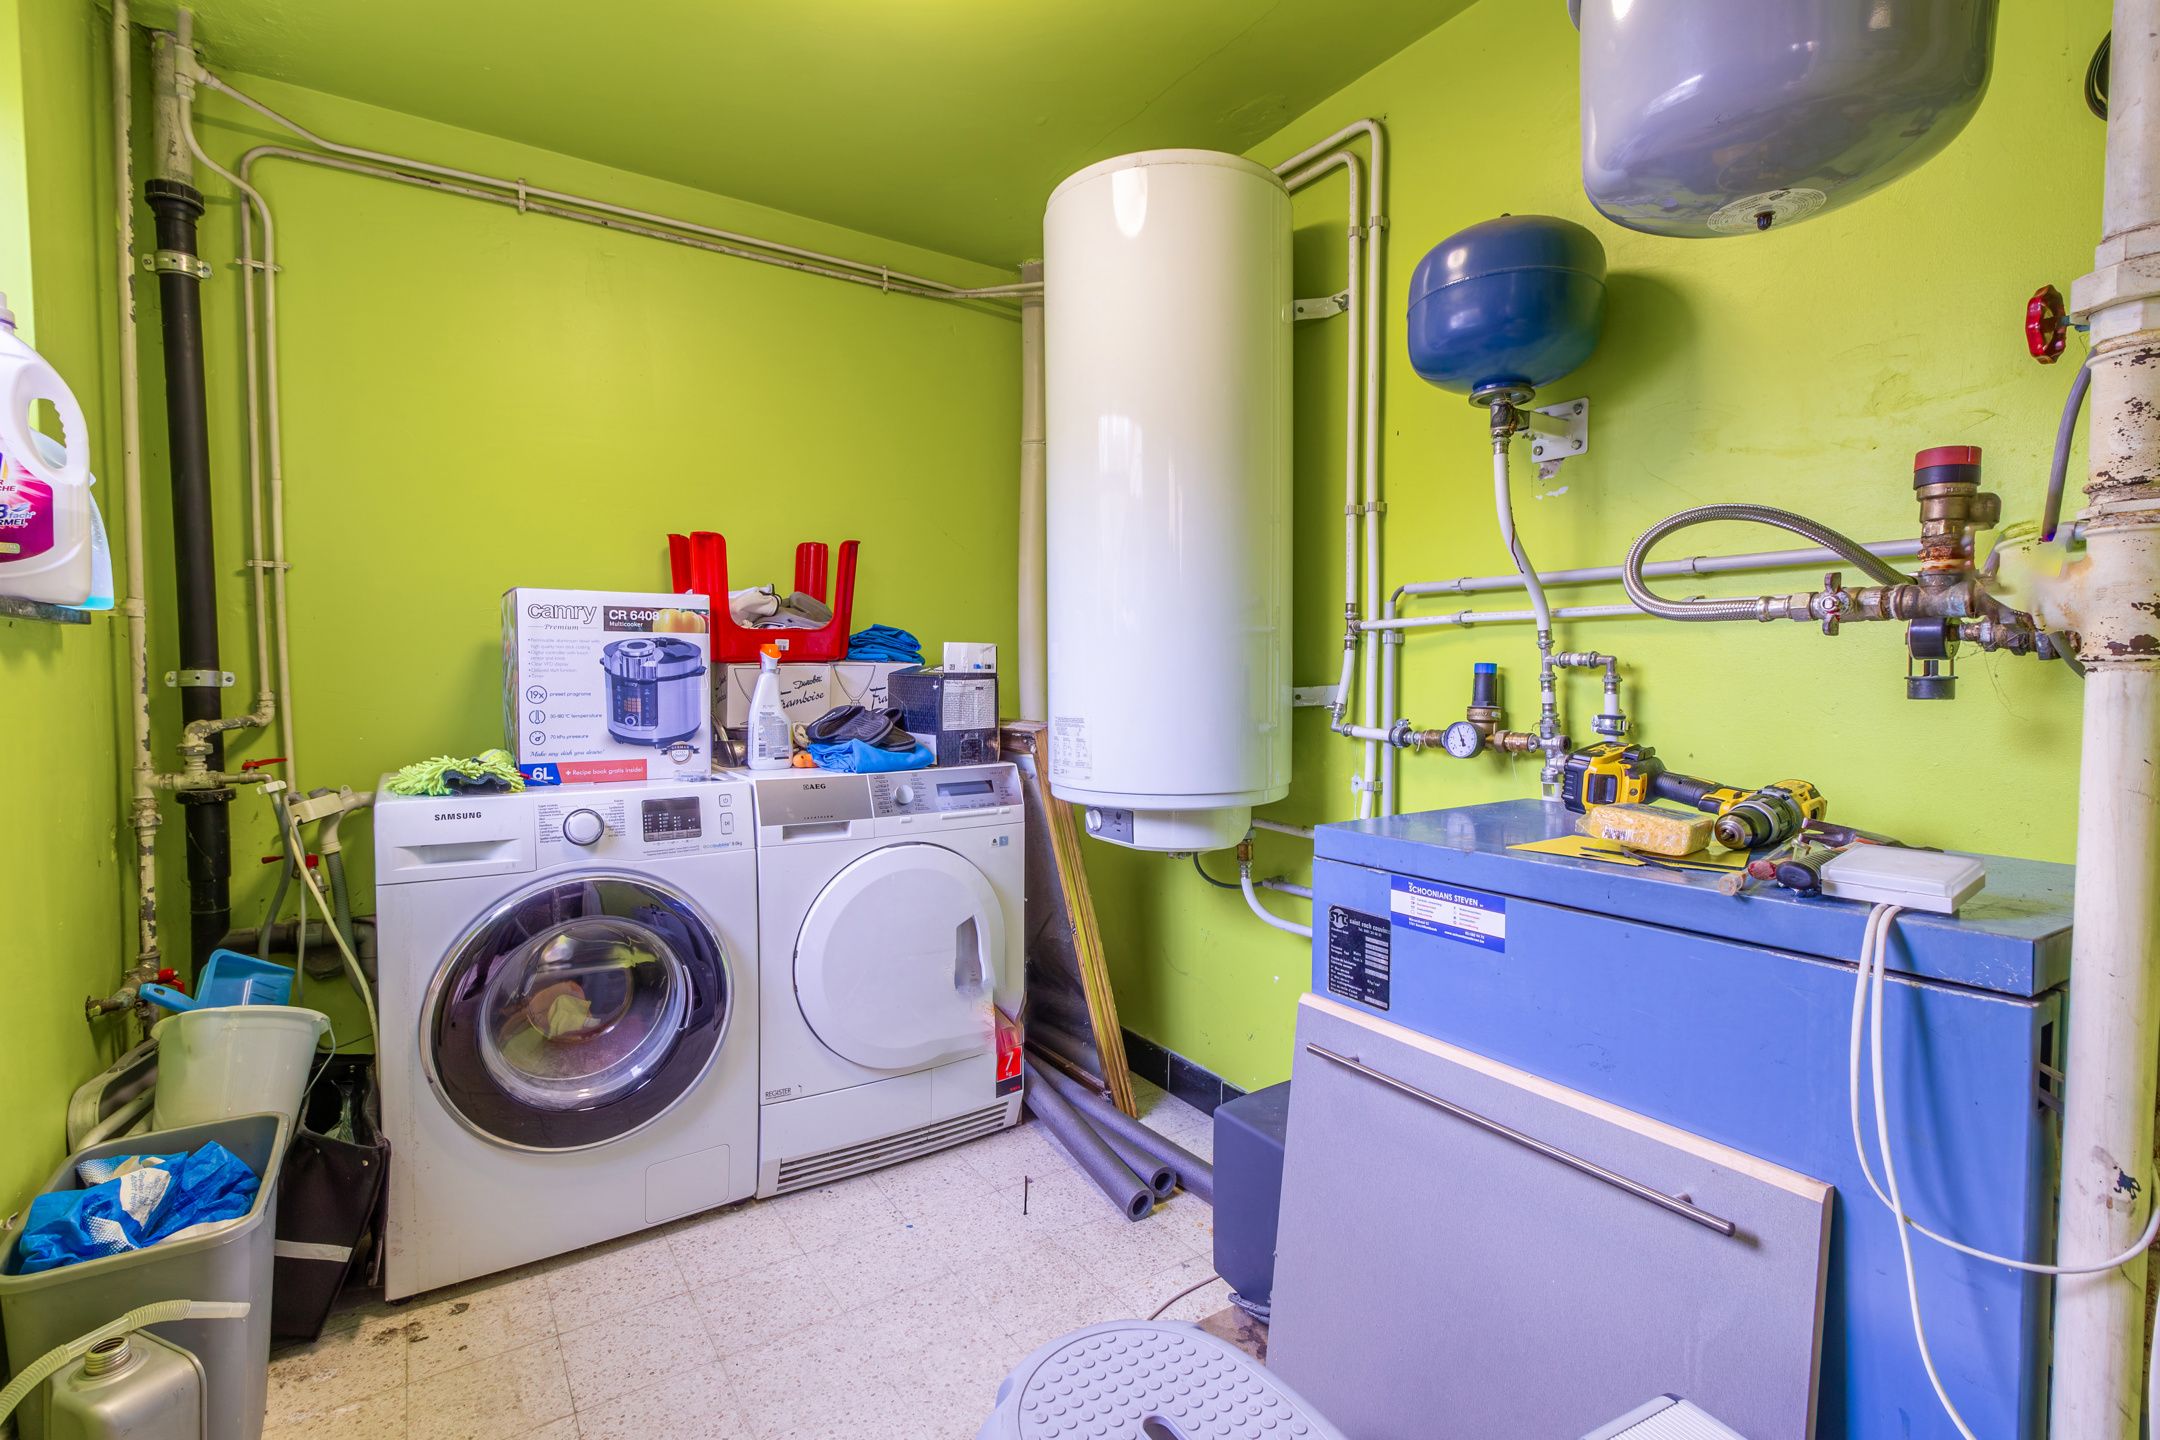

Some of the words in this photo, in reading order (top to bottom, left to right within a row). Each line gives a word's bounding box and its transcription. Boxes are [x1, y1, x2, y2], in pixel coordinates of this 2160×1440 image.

[527, 603, 597, 624] camry
[608, 610, 626, 620] CR
[630, 610, 660, 621] 6408
[530, 690, 544, 699] 19x
[780, 687, 825, 709] ramboise
[532, 767, 554, 780] 6L
[434, 811, 482, 821] SAMSUNG
[1408, 885, 1453, 902] SCHOONIANS
[1454, 894, 1478, 906] STEVEN
[1005, 1051, 1014, 1071] 7
[765, 1087, 791, 1098] REGISTER
